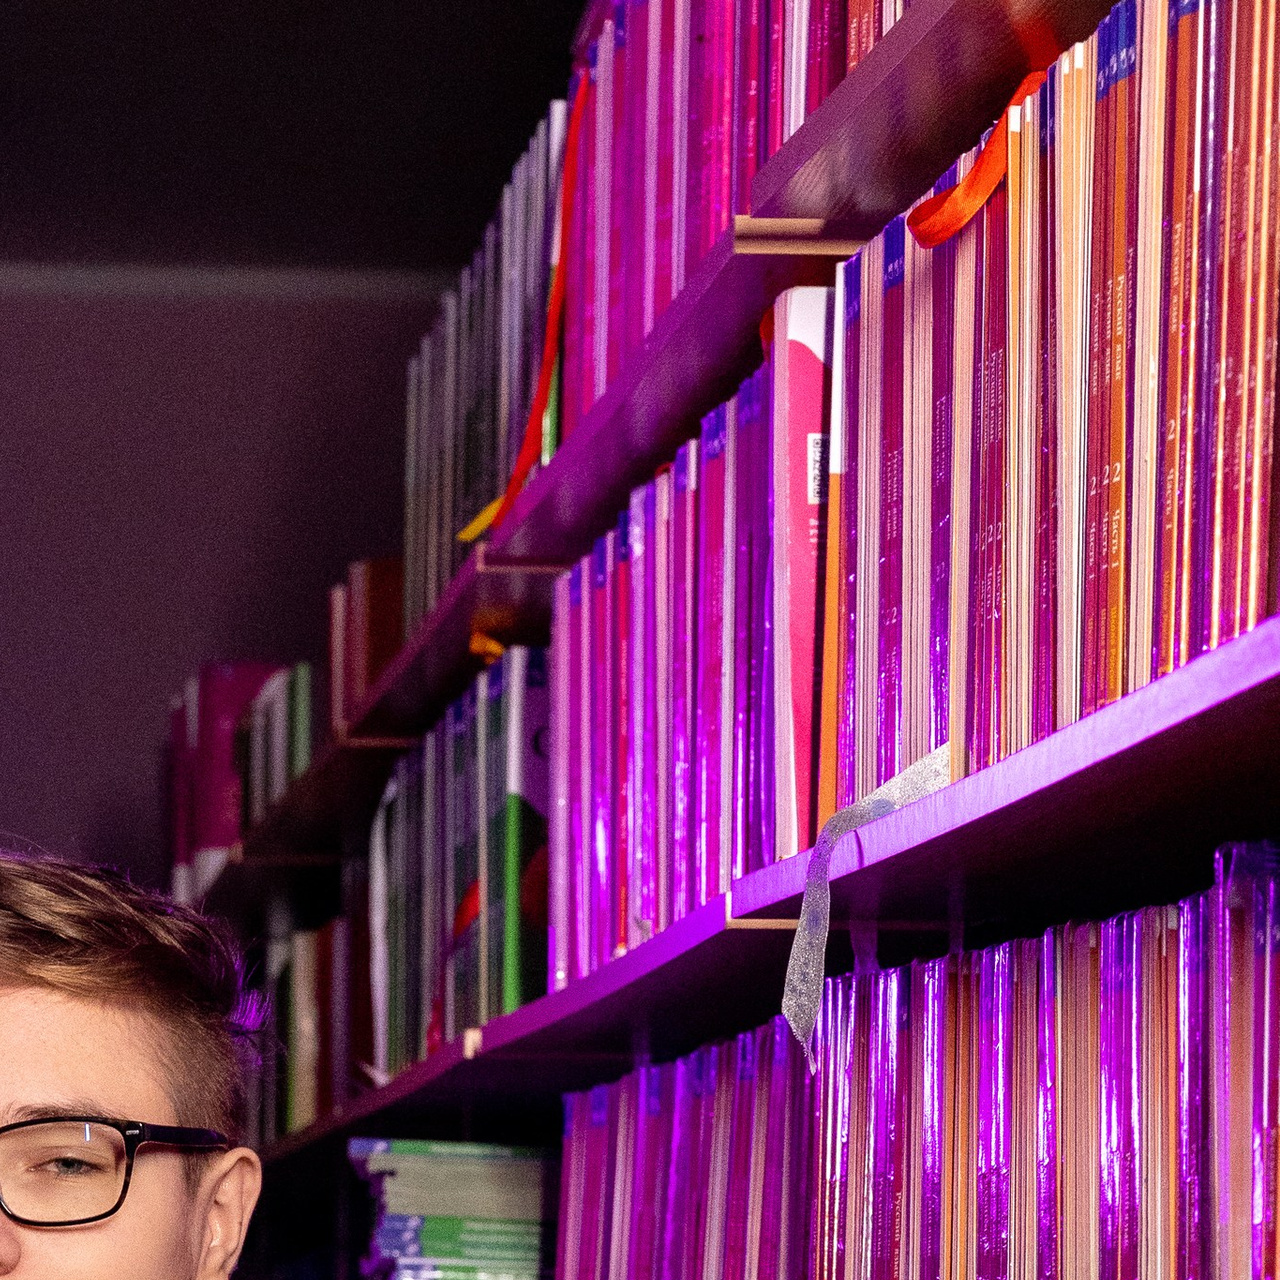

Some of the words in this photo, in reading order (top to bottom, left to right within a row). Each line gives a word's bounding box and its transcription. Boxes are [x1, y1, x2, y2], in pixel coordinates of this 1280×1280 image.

[1172, 222, 1182, 287] Русский
[1093, 293, 1101, 353] Русский
[1105, 279, 1113, 340] Русский
[1116, 274, 1126, 336] Русский
[989, 352, 997, 407] Русский
[1115, 343, 1123, 381] язык
[1167, 419, 1176, 441] 2
[1089, 476, 1097, 496] 2
[1102, 465, 1110, 486] 2
[1112, 462, 1121, 484] 2
[1165, 468, 1175, 515] Часть
[987, 524, 994, 544] 2
[1089, 521, 1097, 566] Часть
[1111, 509, 1121, 554] Часть
[893, 1192, 902, 1242] Русский
